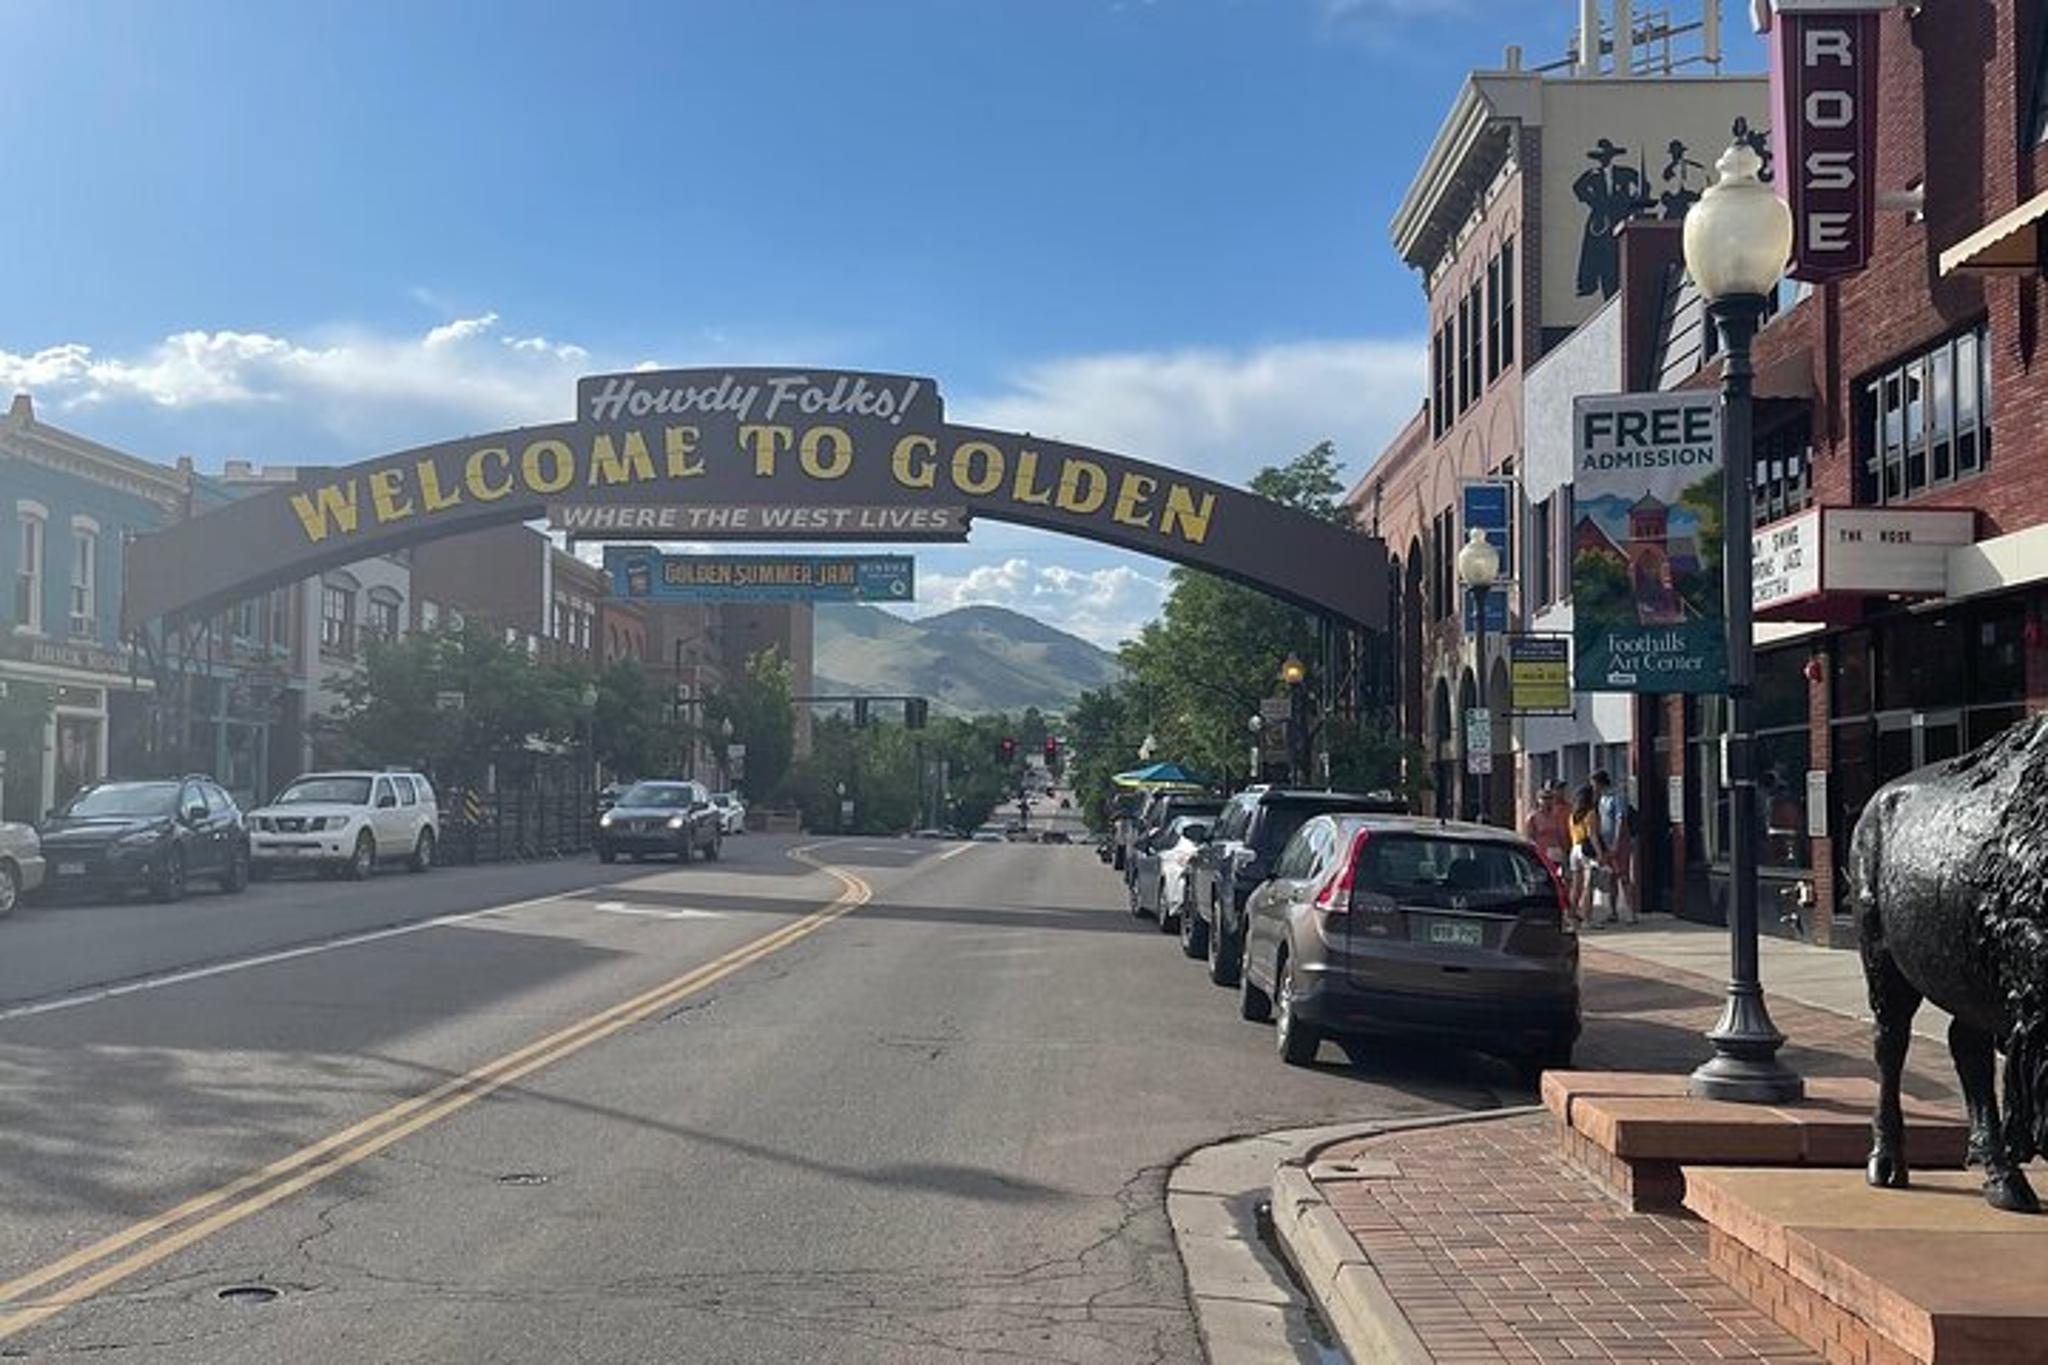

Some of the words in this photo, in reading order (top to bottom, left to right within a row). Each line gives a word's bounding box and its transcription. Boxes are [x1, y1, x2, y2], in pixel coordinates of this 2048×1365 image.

[1804, 29, 1856, 251] ROSE
[591, 374, 759, 421] Howdy
[766, 375, 919, 425] Folks!
[1583, 406, 1713, 450] FREE
[1582, 446, 1714, 472] ADMISSION
[290, 425, 706, 544] WELCOME
[738, 425, 854, 480] TO
[891, 433, 1216, 545] GOLDEN
[562, 507, 678, 528] WHERE
[687, 507, 749, 528] THE
[761, 507, 852, 528] WEST
[860, 507, 949, 528] LIVES
[1840, 529, 1862, 542] THE
[665, 563, 731, 584] GOLDEN
[733, 563, 812, 586] SUMMER
[814, 563, 856, 586] JAM
[1607, 631, 1686, 653] Foothills
[1608, 653, 1640, 671] Art
[1643, 653, 1704, 672] Center
